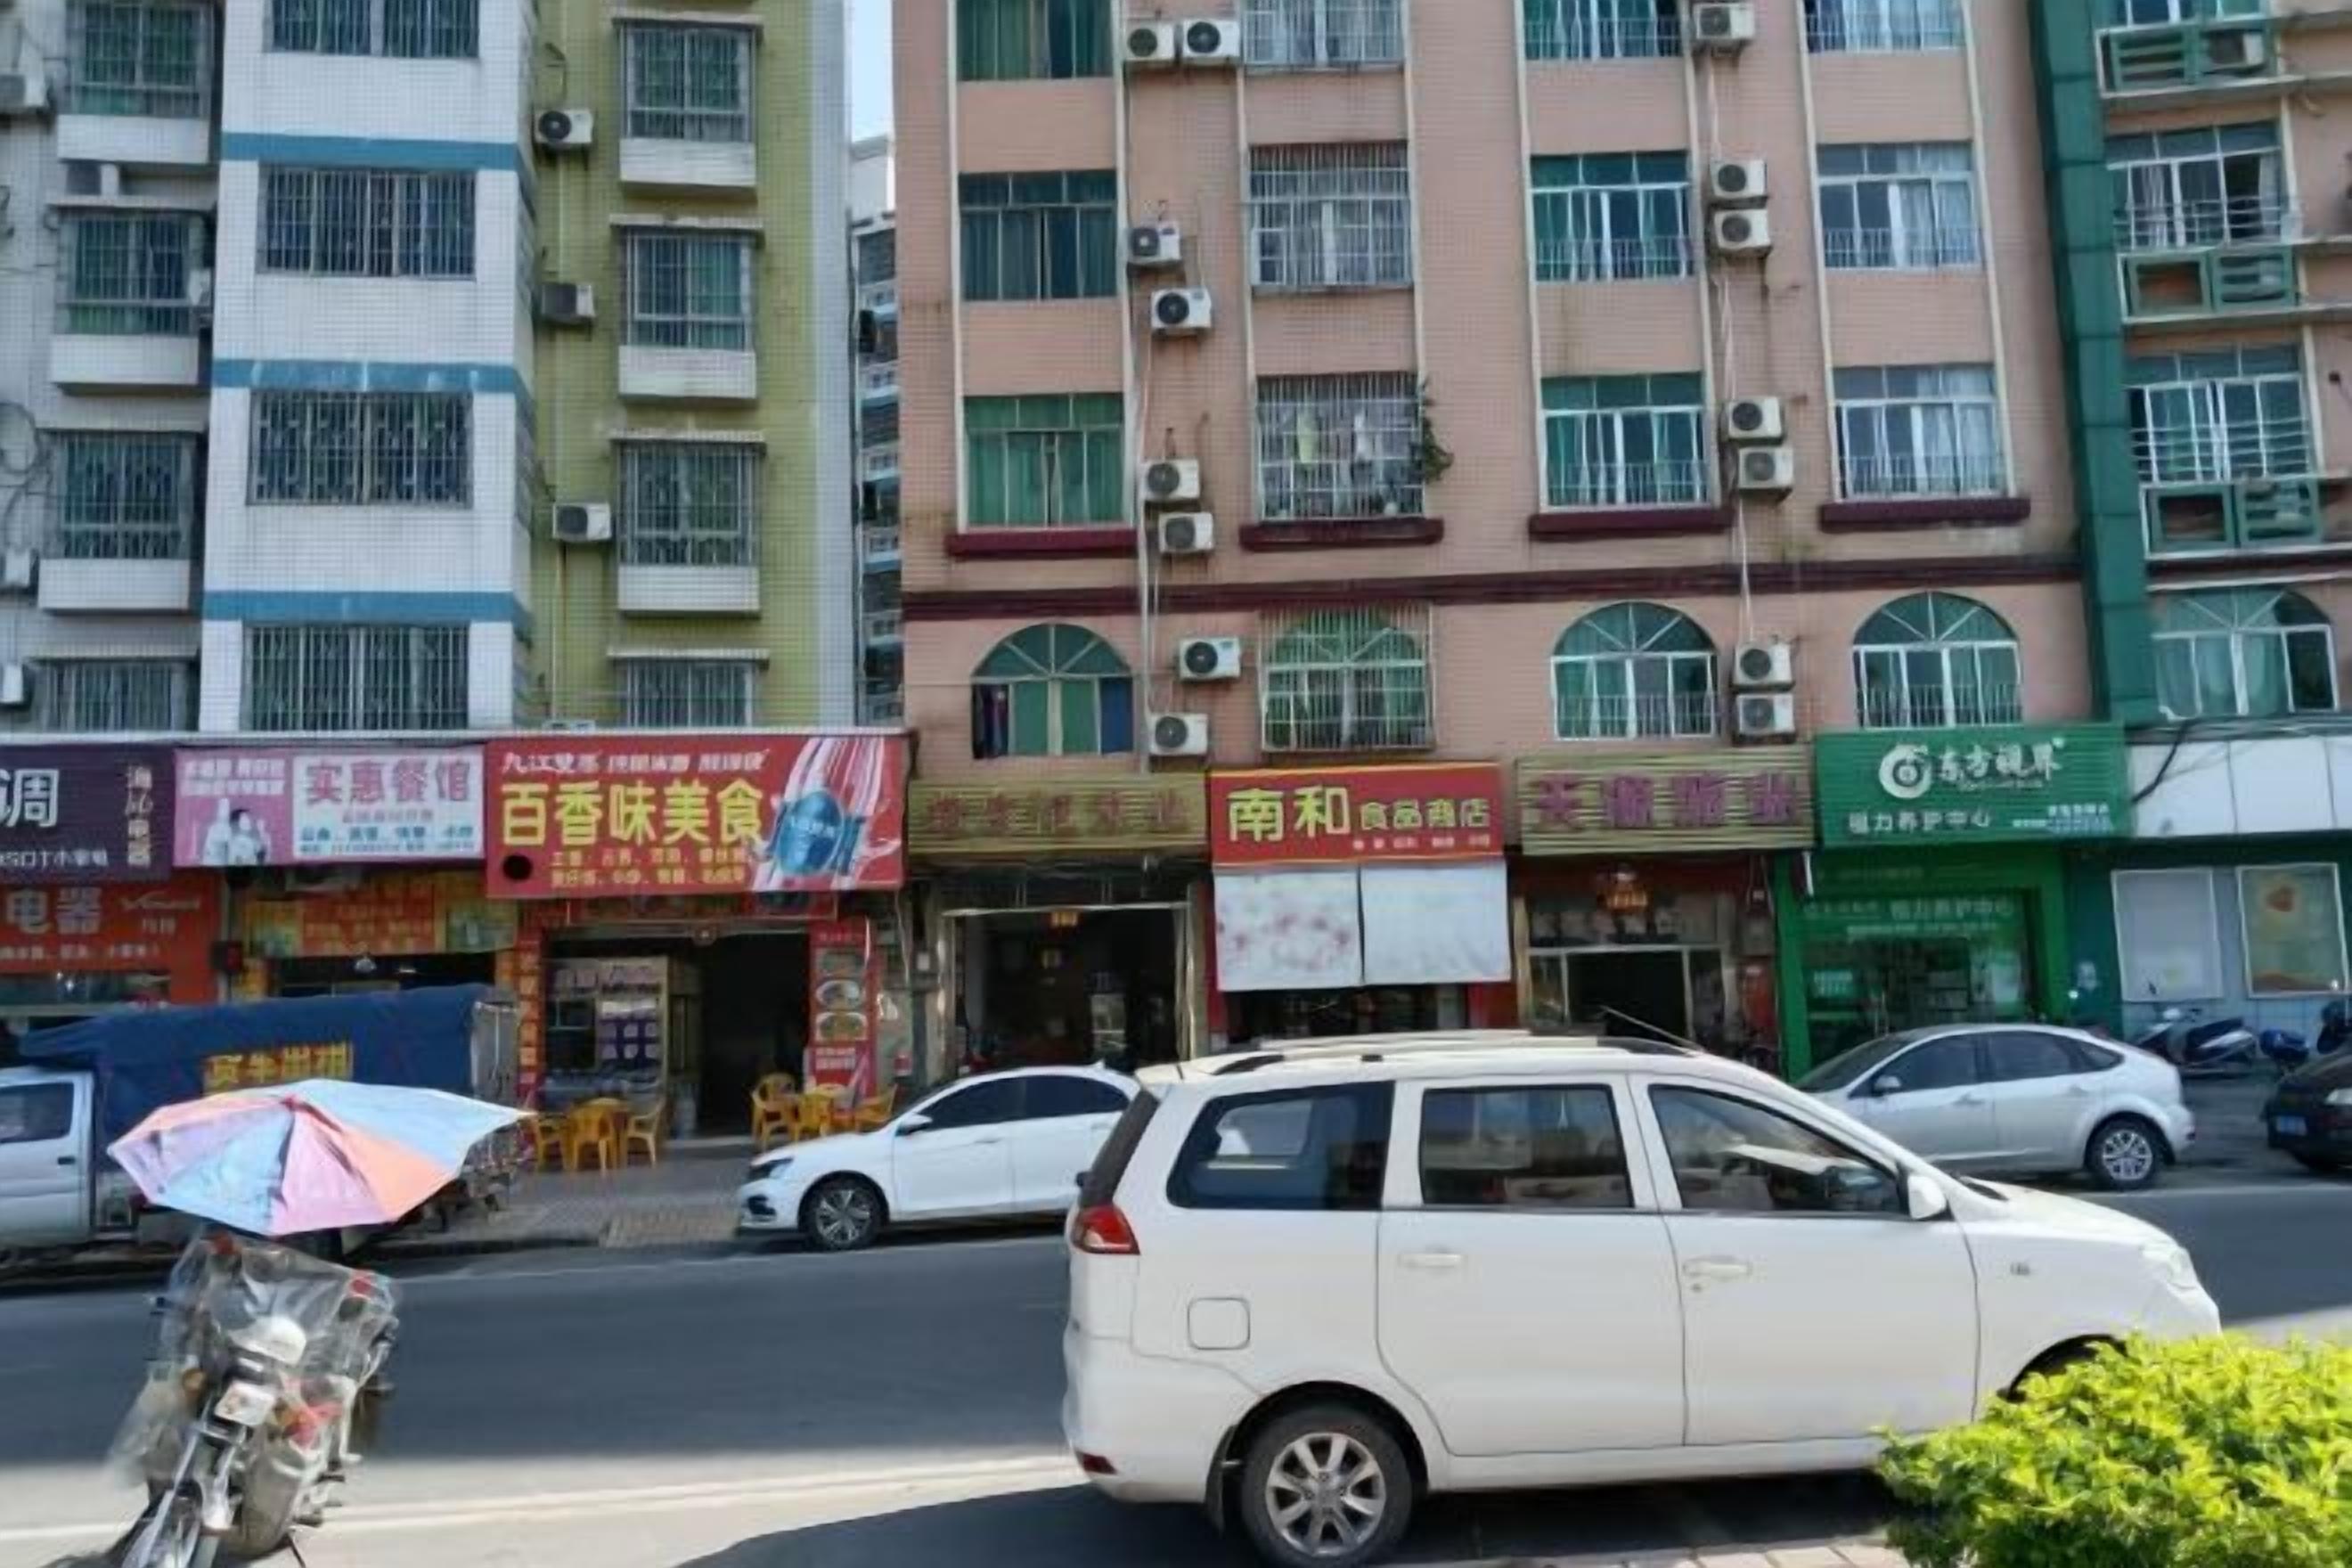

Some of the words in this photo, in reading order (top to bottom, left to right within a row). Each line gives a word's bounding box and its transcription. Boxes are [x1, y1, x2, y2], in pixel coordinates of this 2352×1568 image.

[306, 759, 470, 804] 实惠餐馆
[501, 778, 764, 846] 百香味美食
[1227, 785, 1351, 842] 南和
[1359, 798, 1491, 830] 食品商店
